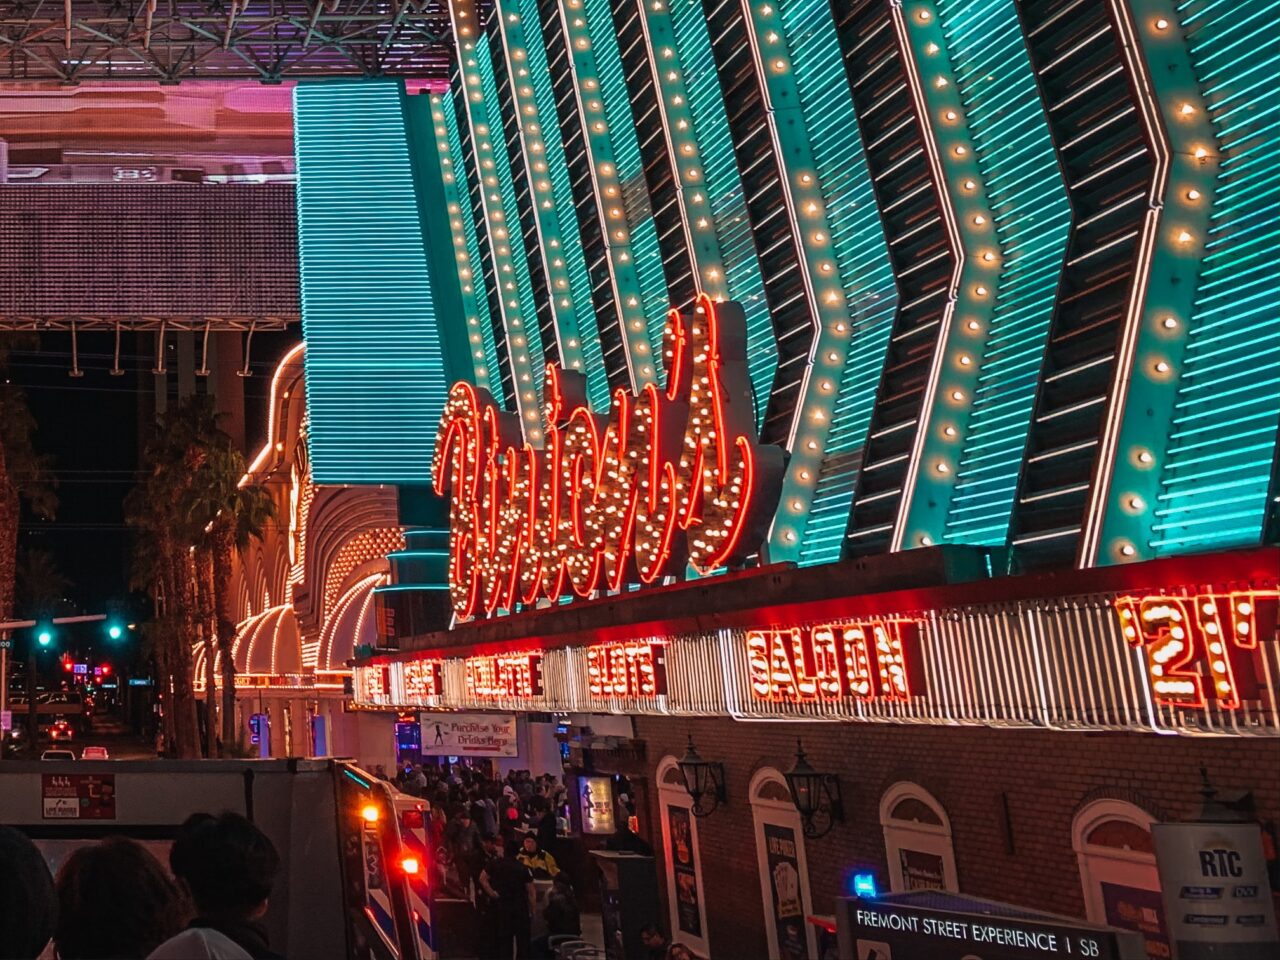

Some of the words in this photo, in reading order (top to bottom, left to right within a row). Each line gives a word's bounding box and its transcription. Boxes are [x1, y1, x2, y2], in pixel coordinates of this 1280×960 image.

[431, 293, 761, 621] Binion's
[587, 642, 657, 699] SLOTS
[745, 618, 911, 704] SALOON
[451, 723, 490, 733] Purchase
[491, 723, 511, 735] Your
[1198, 849, 1244, 878] RTC
[857, 910, 919, 933] FREMONT
[923, 919, 968, 940] STREET
[972, 925, 1058, 952] EXPERIENCE
[1080, 939, 1100, 957] SB
